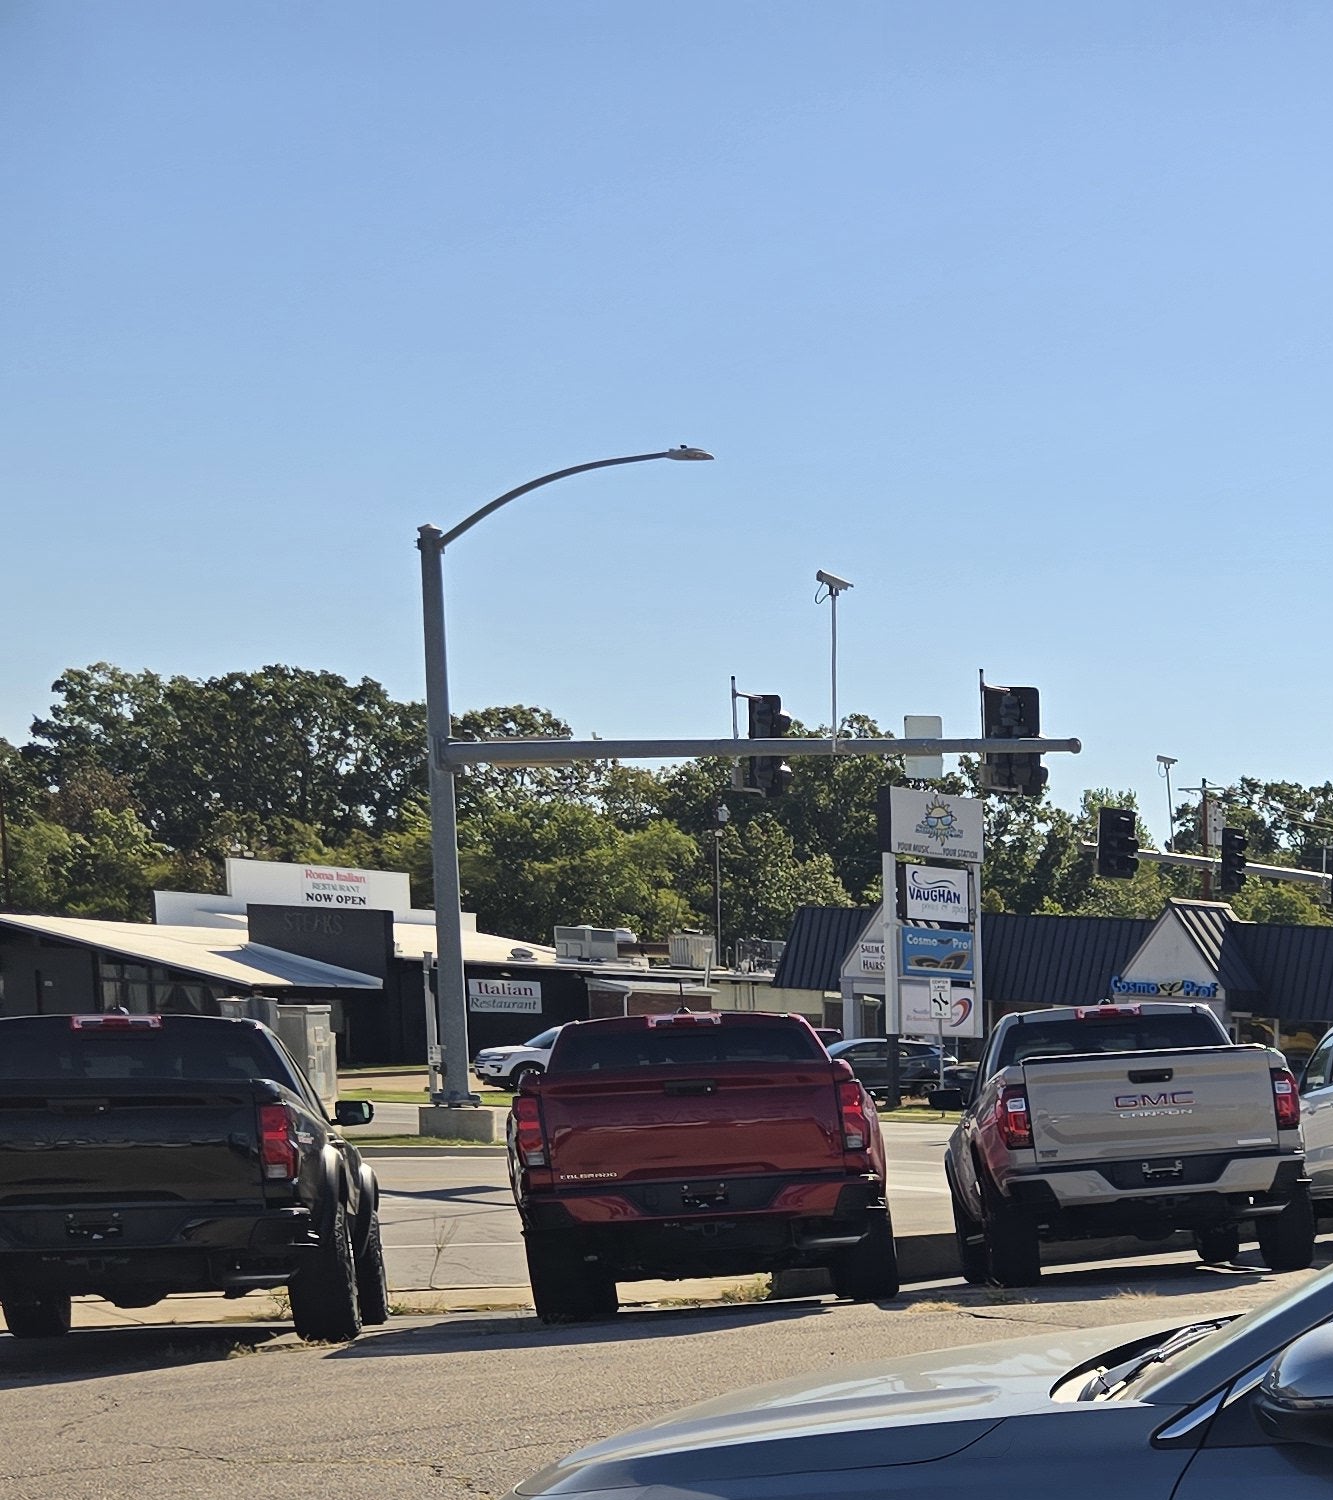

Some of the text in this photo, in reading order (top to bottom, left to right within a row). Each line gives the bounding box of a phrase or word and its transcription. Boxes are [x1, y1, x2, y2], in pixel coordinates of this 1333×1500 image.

[957, 849, 978, 859] STATION
[305, 869, 366, 883] Roma Italian
[306, 893, 366, 905] NOW OPEN
[909, 886, 960, 904] VAUGHAN
[907, 934, 938, 947] Cosmo
[863, 960, 885, 970] HAIRS
[477, 982, 533, 996] Italian
[1111, 976, 1218, 997] Cosmo Prof
[471, 998, 536, 1009] Restaurant
[1115, 1091, 1194, 1109] GMC
